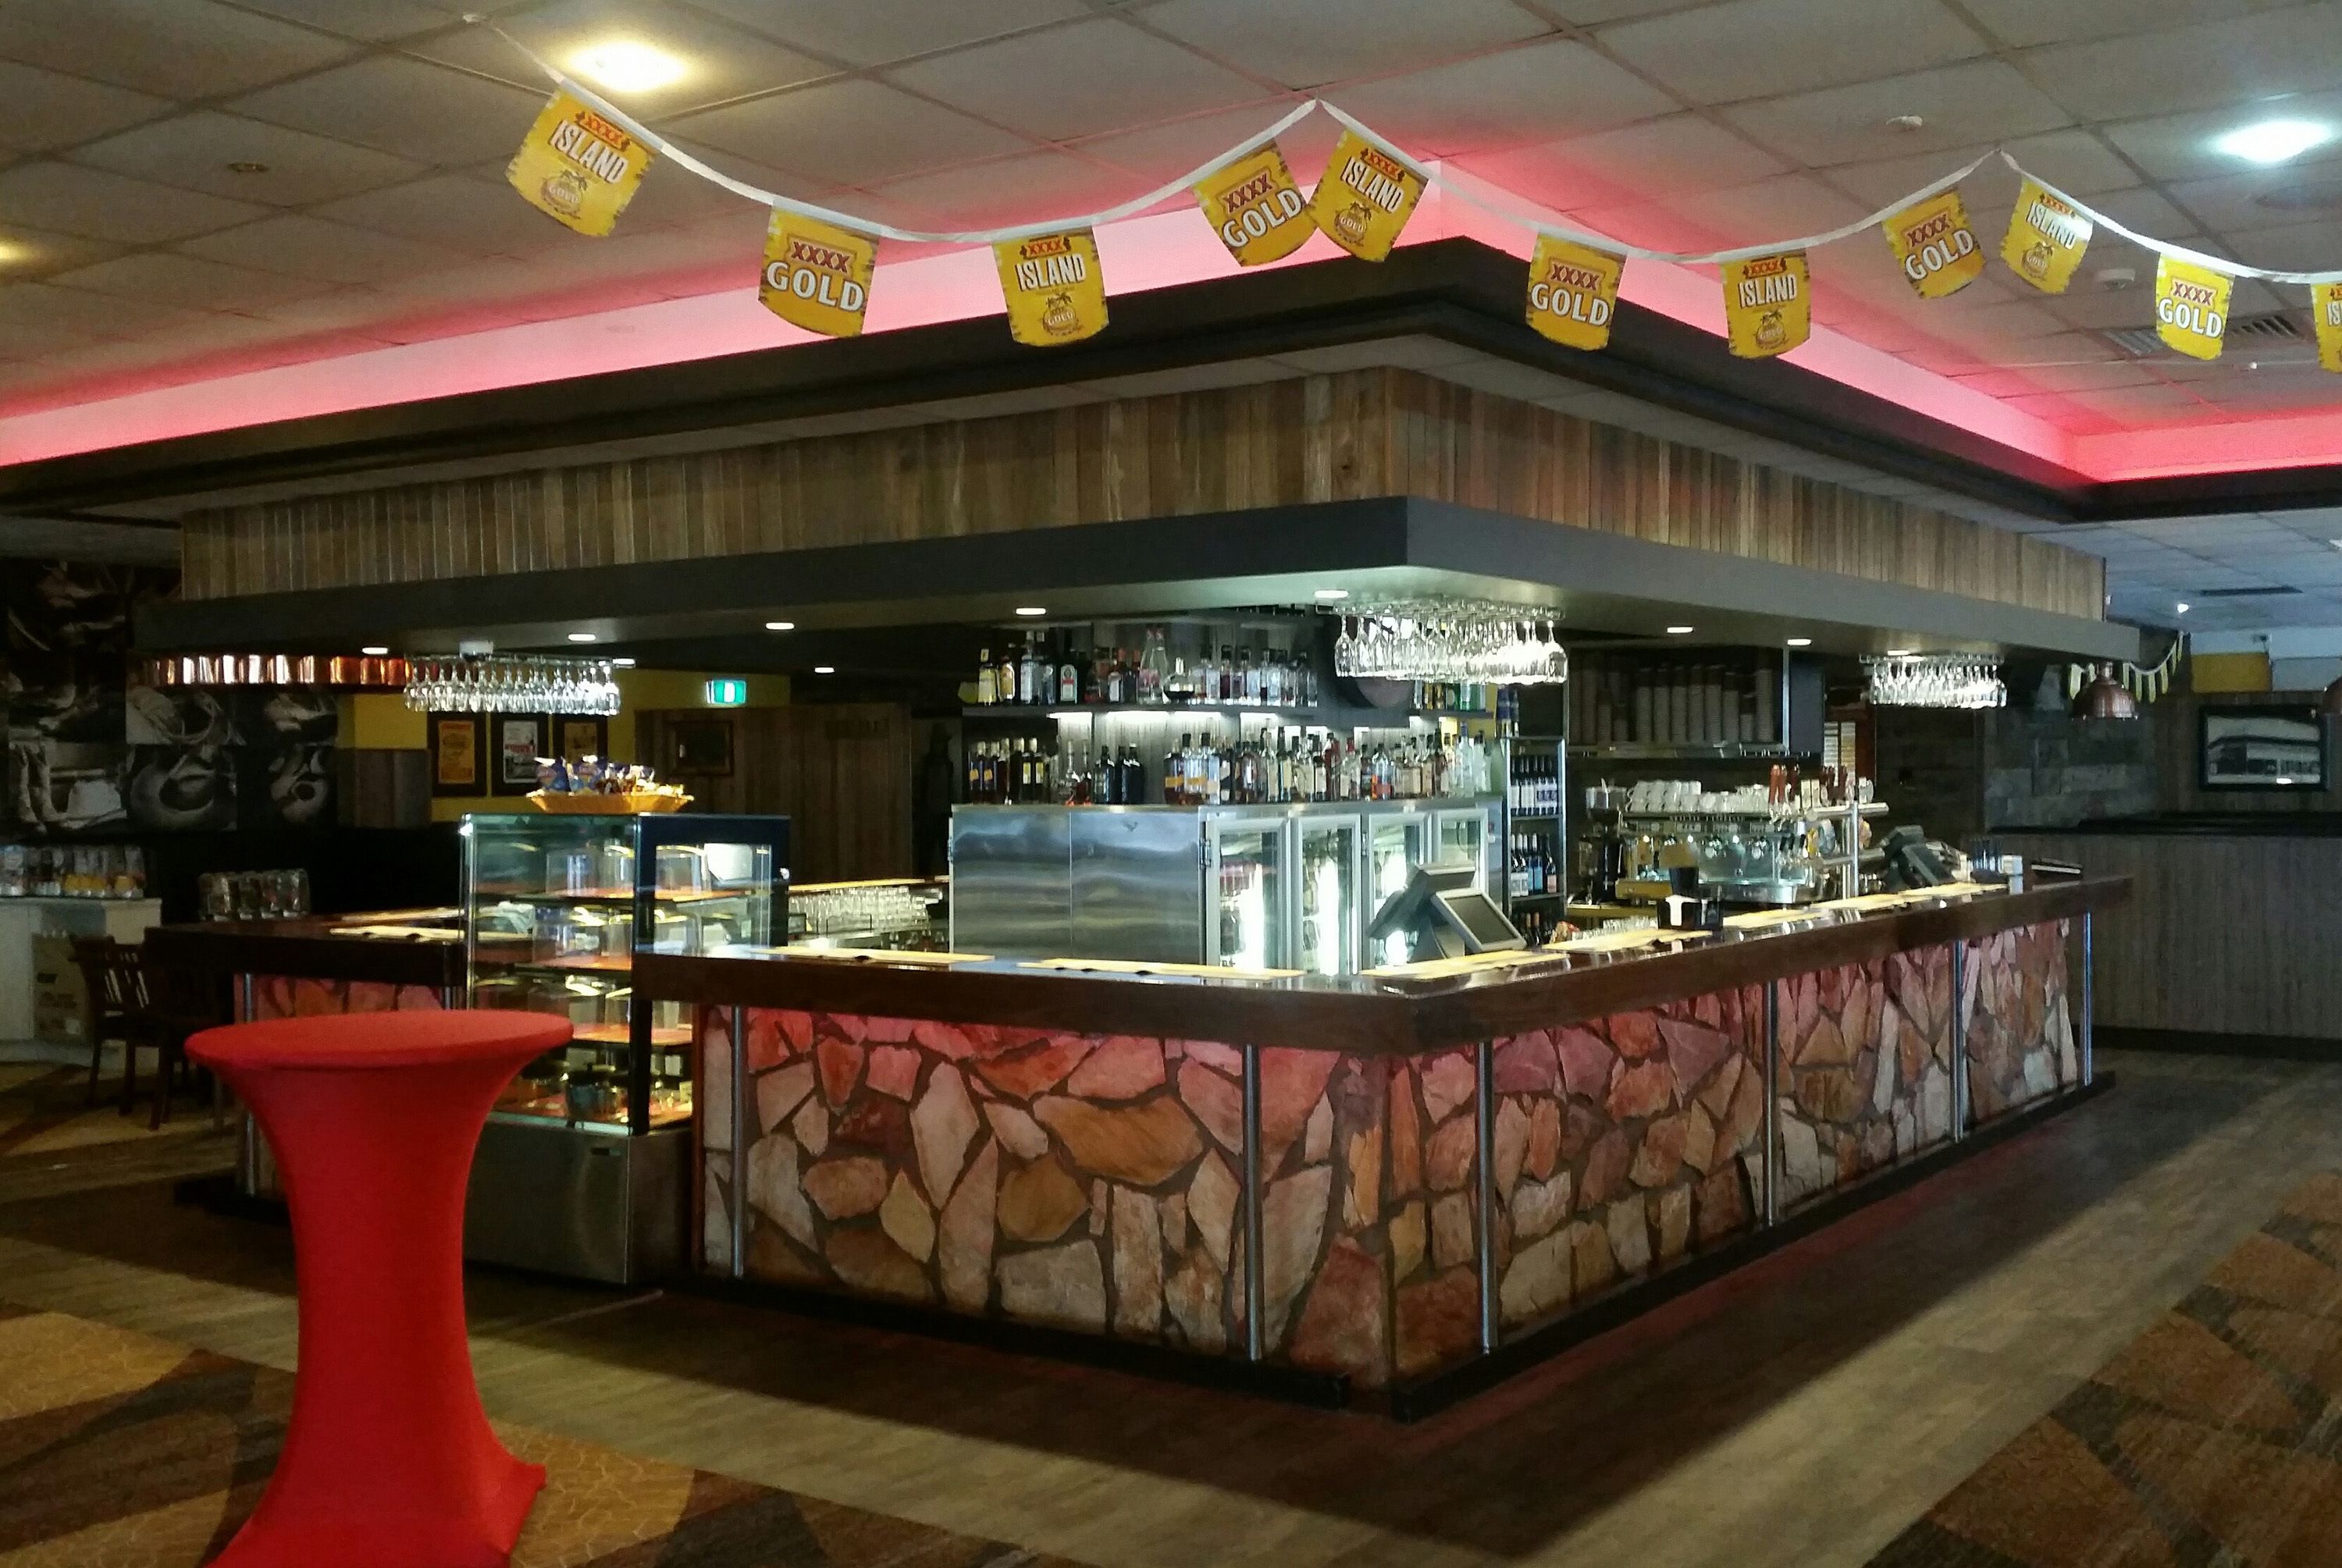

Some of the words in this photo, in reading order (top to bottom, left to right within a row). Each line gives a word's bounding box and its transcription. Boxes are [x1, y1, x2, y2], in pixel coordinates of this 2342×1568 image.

[549, 119, 628, 184] ISLAND
[1223, 173, 1273, 213] XXXX
[1340, 156, 1404, 213] ISLAND
[1223, 188, 1302, 247] GOLD
[1340, 217, 1364, 232] GOLD
[1907, 214, 1950, 247] XXXX
[2026, 200, 2075, 250] ISLAND
[791, 241, 849, 272] XXXX
[1029, 240, 1062, 255] XXXX
[1905, 229, 1974, 279] GOLD
[767, 261, 865, 311] GOLD
[1016, 253, 1086, 291] ISLAND
[1550, 264, 1599, 290] XXXX
[1738, 273, 1796, 309] ISLAND
[1531, 283, 1609, 325] GOLD
[2173, 281, 2213, 306] XXXX
[2159, 298, 2223, 338] GOLD
